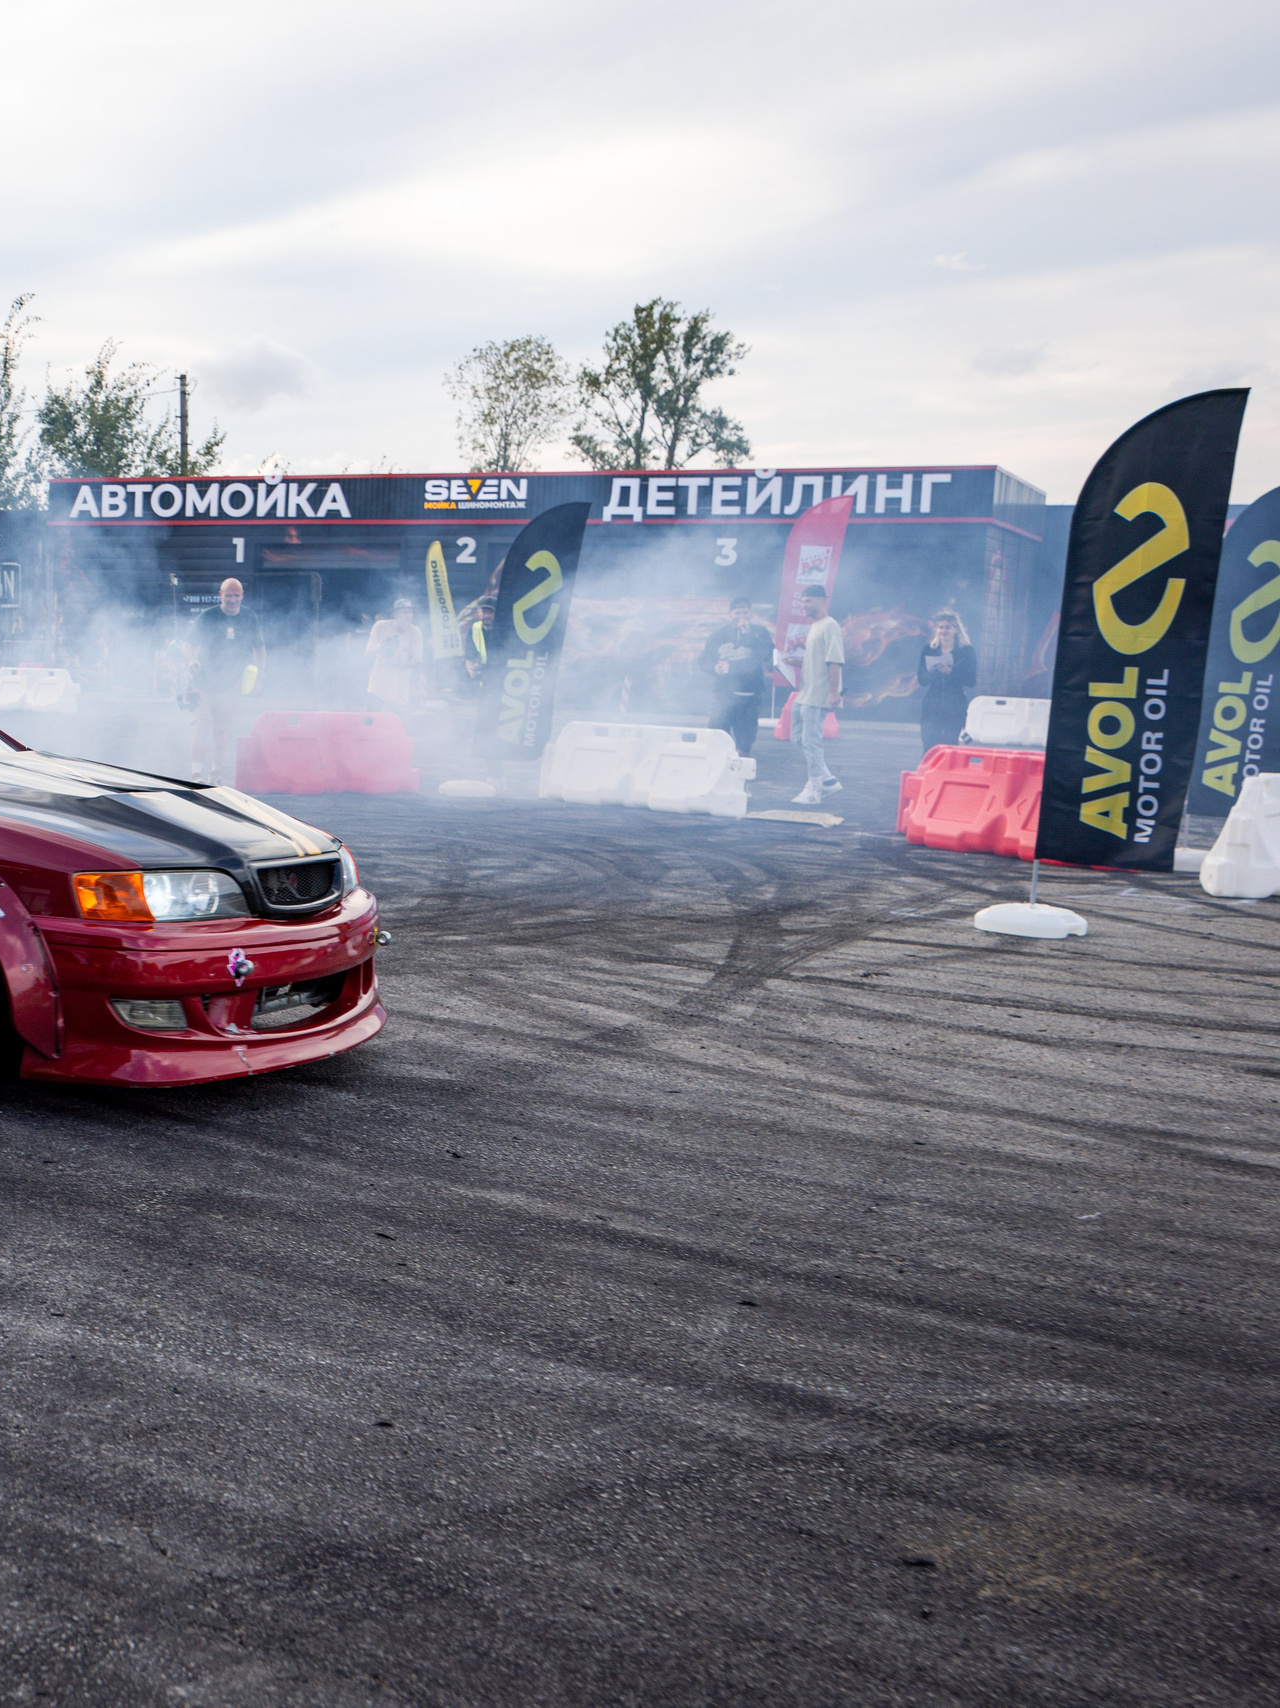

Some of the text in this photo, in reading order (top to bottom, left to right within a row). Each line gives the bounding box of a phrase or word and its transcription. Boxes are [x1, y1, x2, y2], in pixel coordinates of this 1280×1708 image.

[70, 475, 352, 518] АВТОМОЙКА
[458, 501, 526, 509] ШИНОМОНТАЖ
[602, 468, 952, 523] ДЕТЕЙЛИНГ
[232, 537, 245, 563] 1
[456, 537, 477, 564] 2
[715, 538, 738, 567] 3
[523, 651, 549, 747] MOTOR OIL
[1242, 673, 1273, 779] OTOR OIL
[1079, 666, 1139, 841] AVOL
[1133, 668, 1169, 843] MOTOR OIL
[1202, 671, 1253, 797] AVOL
